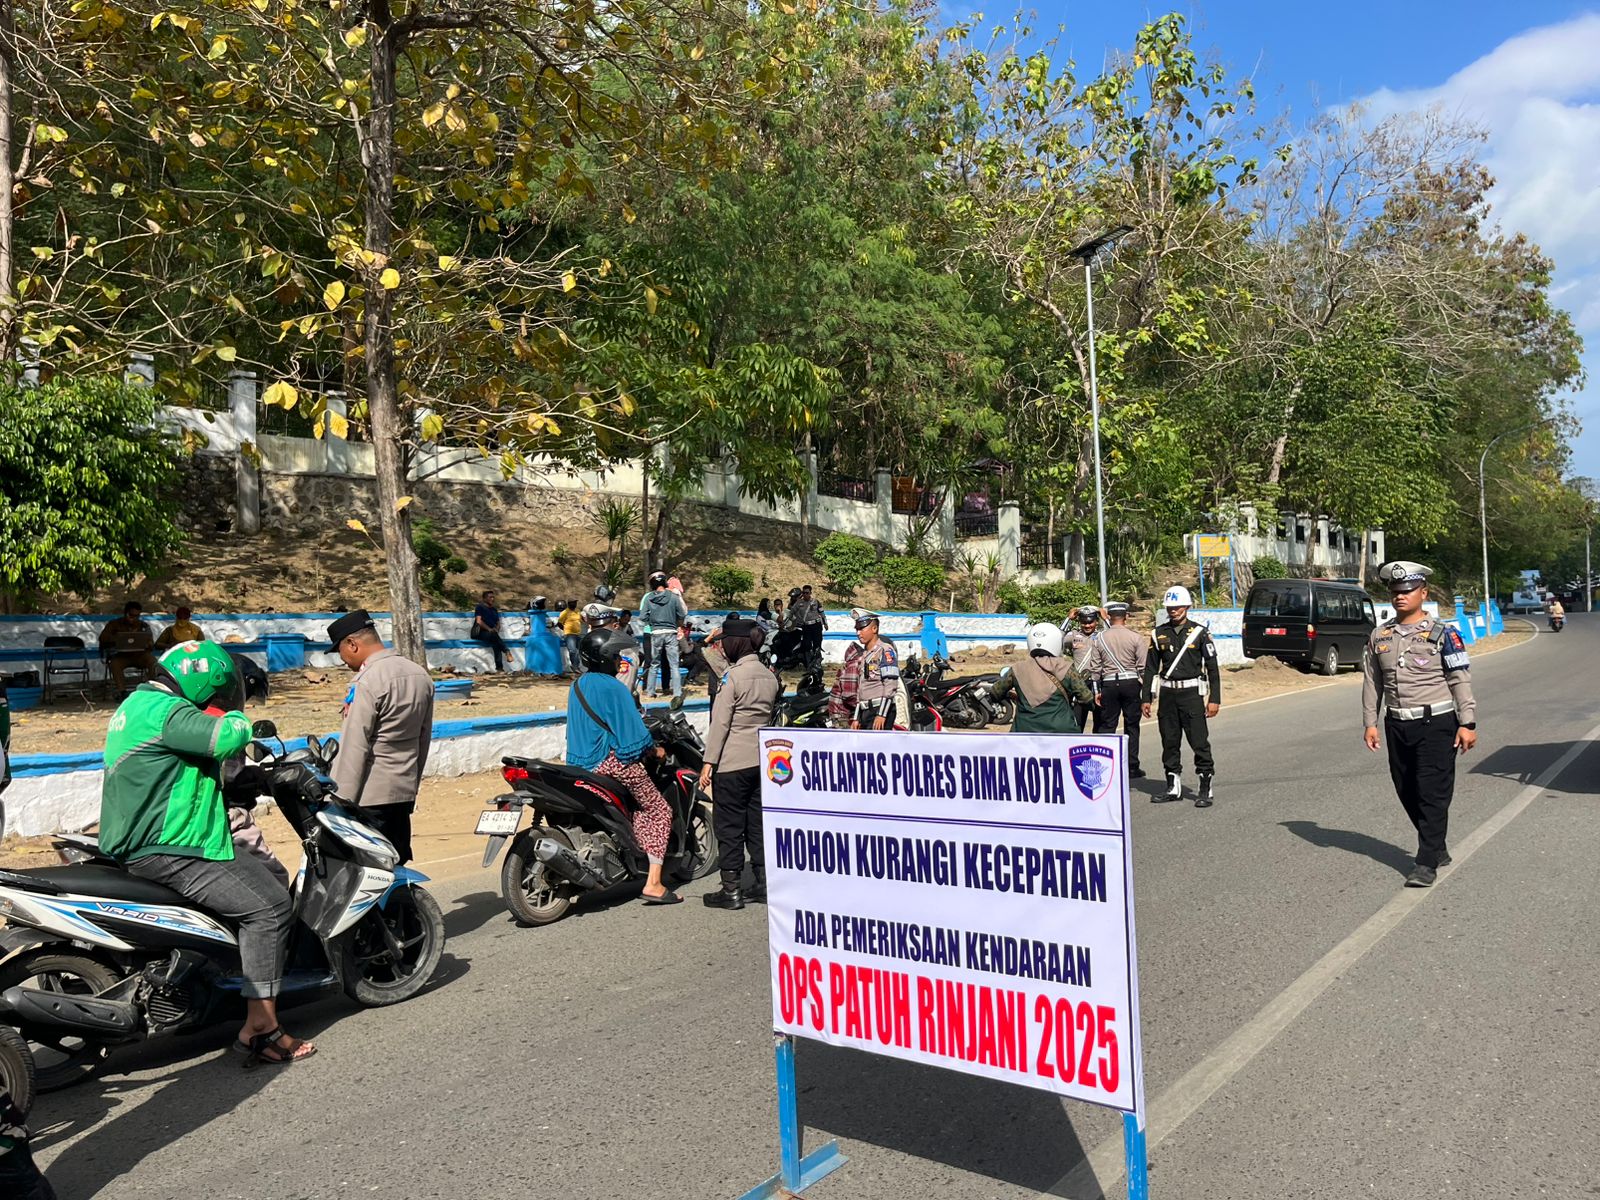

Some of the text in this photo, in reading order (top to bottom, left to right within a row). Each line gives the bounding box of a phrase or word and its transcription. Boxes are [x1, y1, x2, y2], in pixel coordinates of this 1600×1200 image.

[800, 750, 1066, 805] SATLANTAS POLRES BIMA KOTA
[1072, 747, 1110, 756] LALU LINTAS
[367, 874, 390, 883] HONDA
[775, 828, 1107, 903] MOHON KURANGI KECEPATAN
[95, 902, 160, 923] VARIO
[794, 909, 1092, 988] ADA PEMERIKSAAN KENDARAAN
[778, 953, 1120, 1093] OPS PATUH RINJANI 2025
